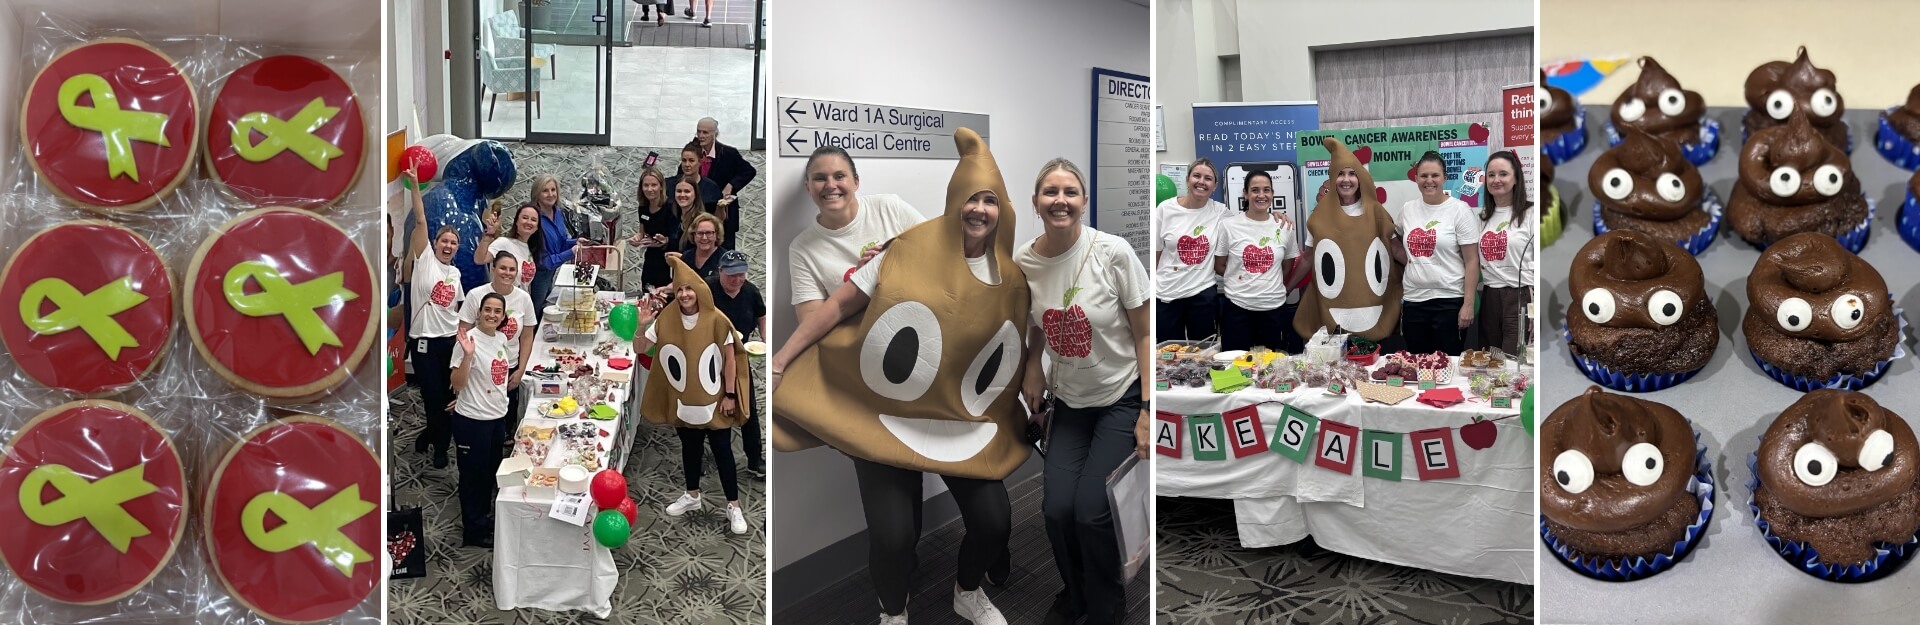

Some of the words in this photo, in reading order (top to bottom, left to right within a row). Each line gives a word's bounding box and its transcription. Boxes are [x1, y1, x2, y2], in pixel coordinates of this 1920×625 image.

[812, 102, 858, 122] Ward
[864, 107, 884, 124] 1A
[889, 108, 944, 131] Surgical
[814, 131, 878, 150] Medical
[883, 134, 931, 152] Centre
[1199, 133, 1228, 141] READ
[1234, 131, 1281, 140] TODAY'S
[1301, 134, 1335, 146] BOW
[1344, 132, 1387, 146] CANCER
[1391, 128, 1458, 143] AWARENESS
[1239, 144, 1267, 152] EASY
[1374, 150, 1412, 162] MONTH
[1157, 419, 1255, 449] AKE
[1283, 420, 1446, 468] SALE
